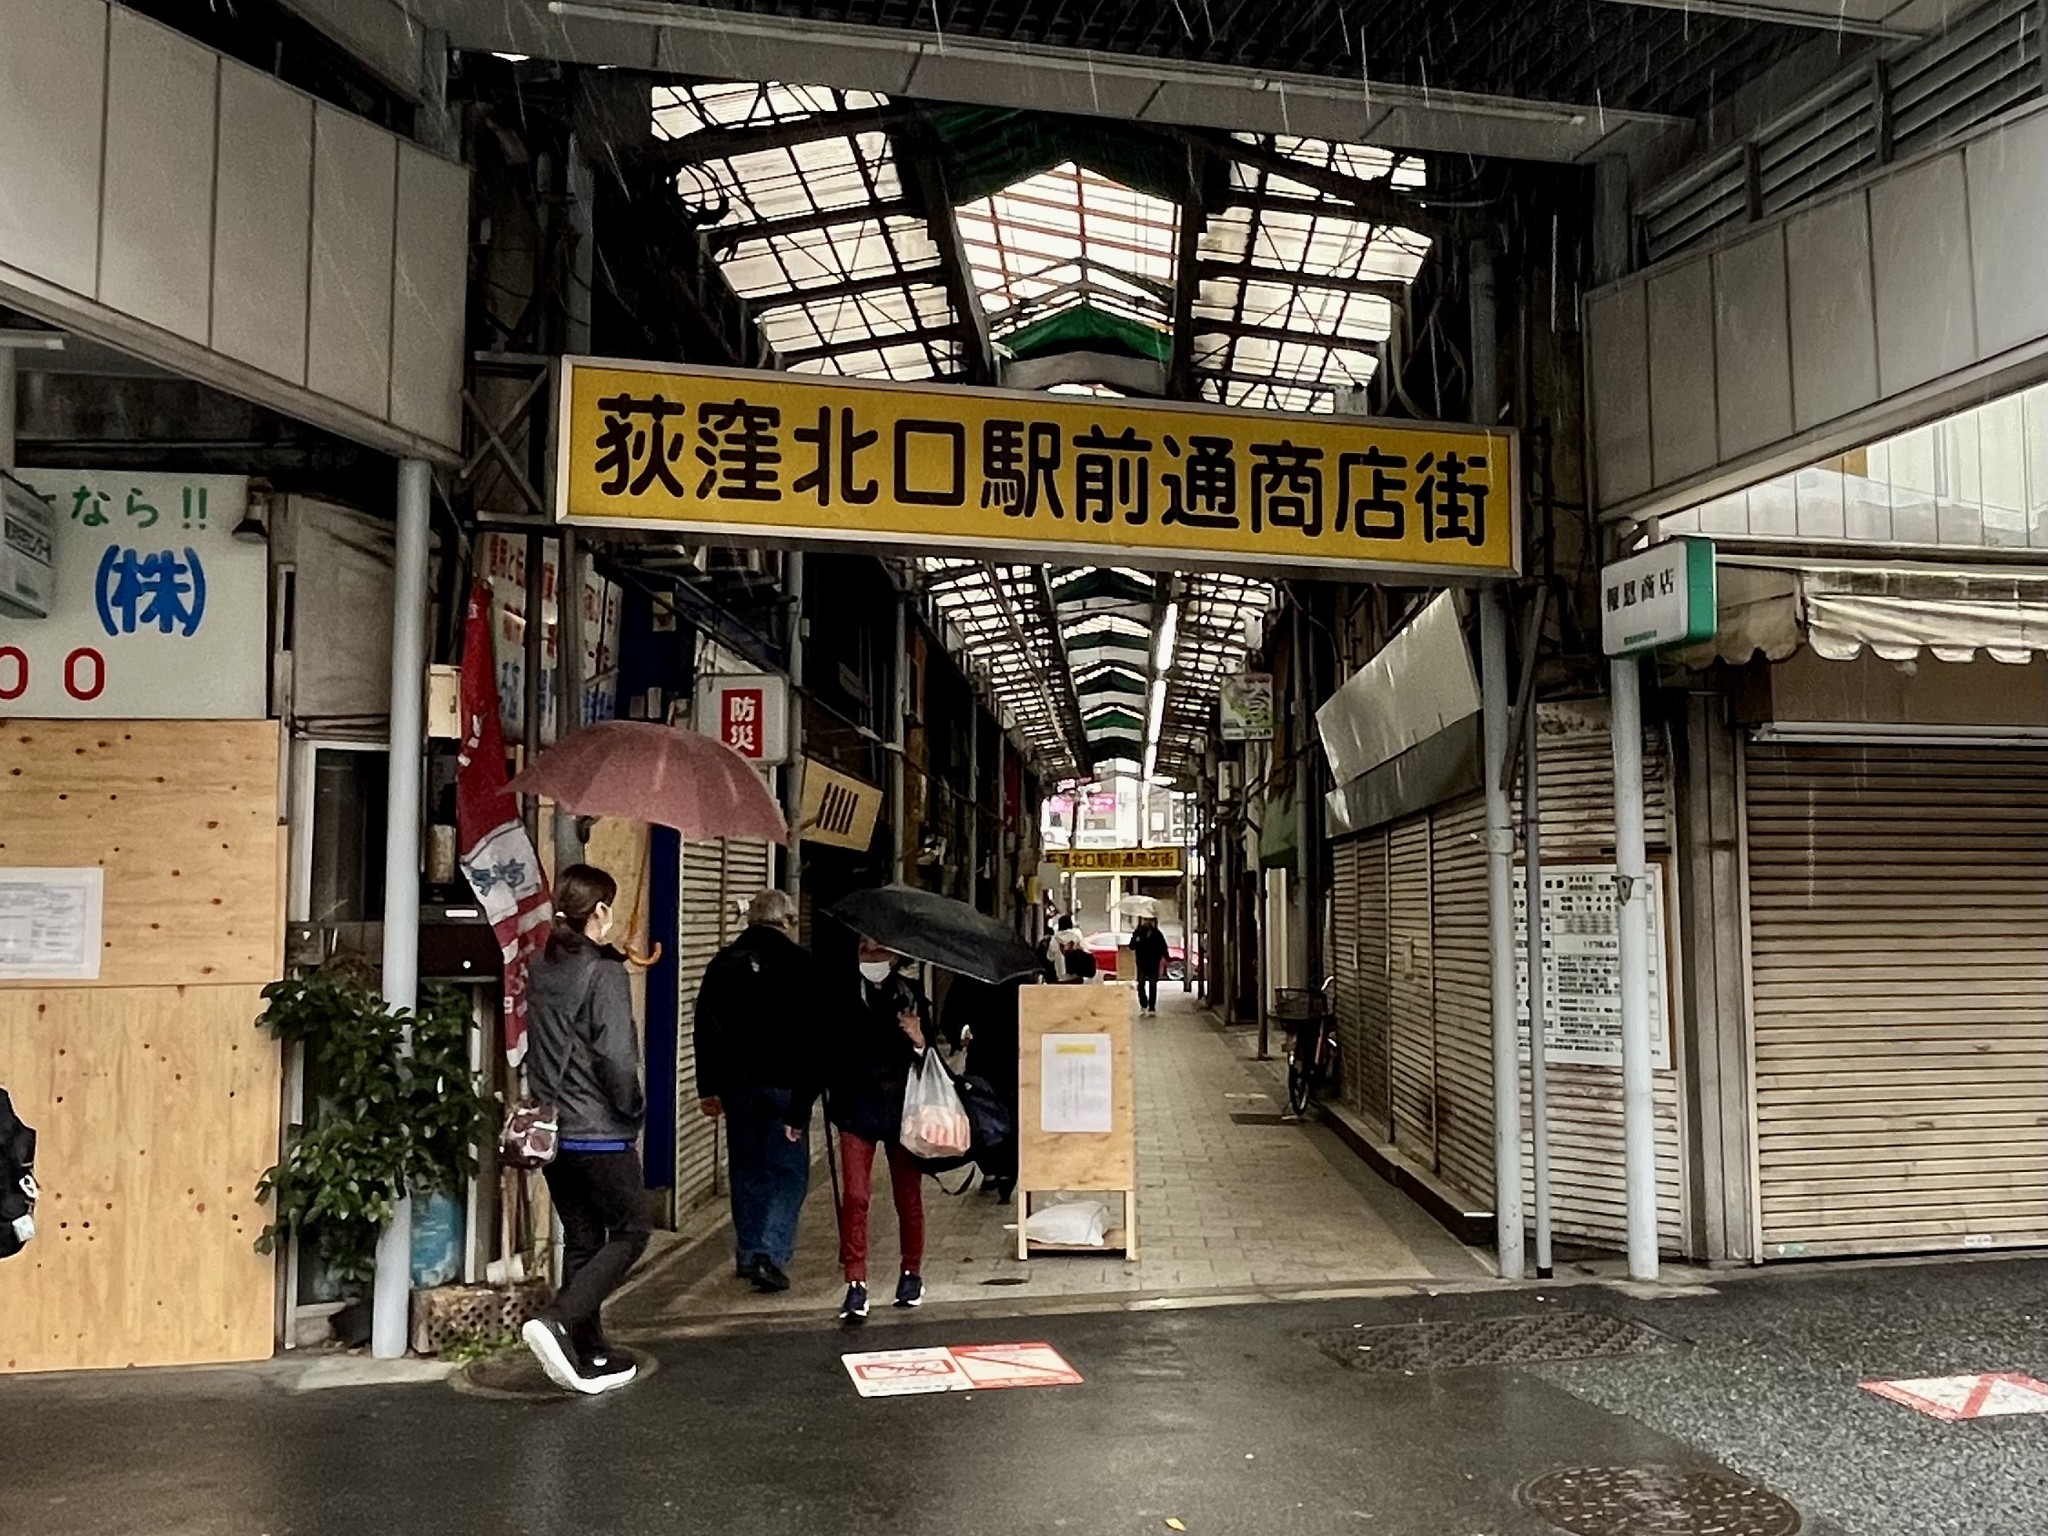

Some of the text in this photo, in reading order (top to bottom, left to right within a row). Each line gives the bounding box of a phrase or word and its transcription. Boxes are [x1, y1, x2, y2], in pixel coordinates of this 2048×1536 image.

[595, 393, 1491, 547] 荻窪北口駅前通商店街
[730, 696, 756, 750] 防災
